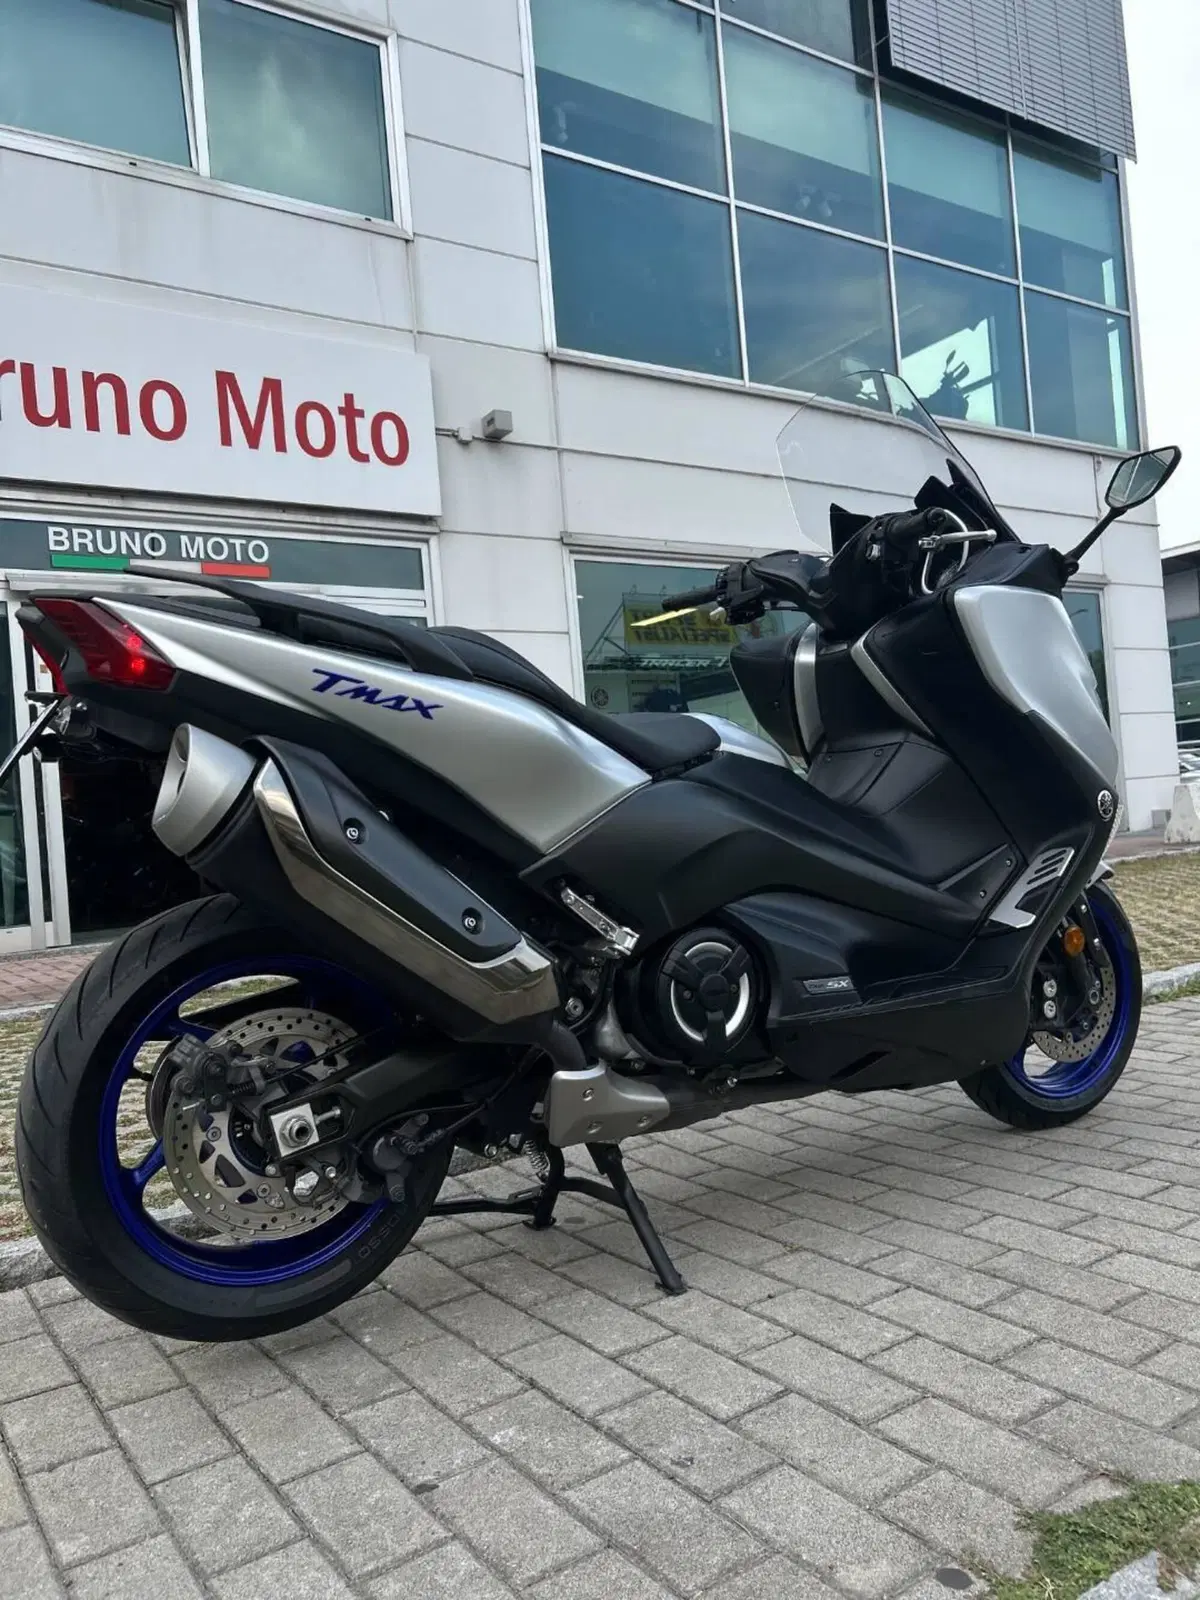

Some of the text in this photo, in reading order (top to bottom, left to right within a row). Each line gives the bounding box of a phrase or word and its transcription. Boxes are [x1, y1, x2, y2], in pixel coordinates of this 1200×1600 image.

[215, 370, 410, 467] Moto
[47, 526, 270, 564] BRUNO MOTO
